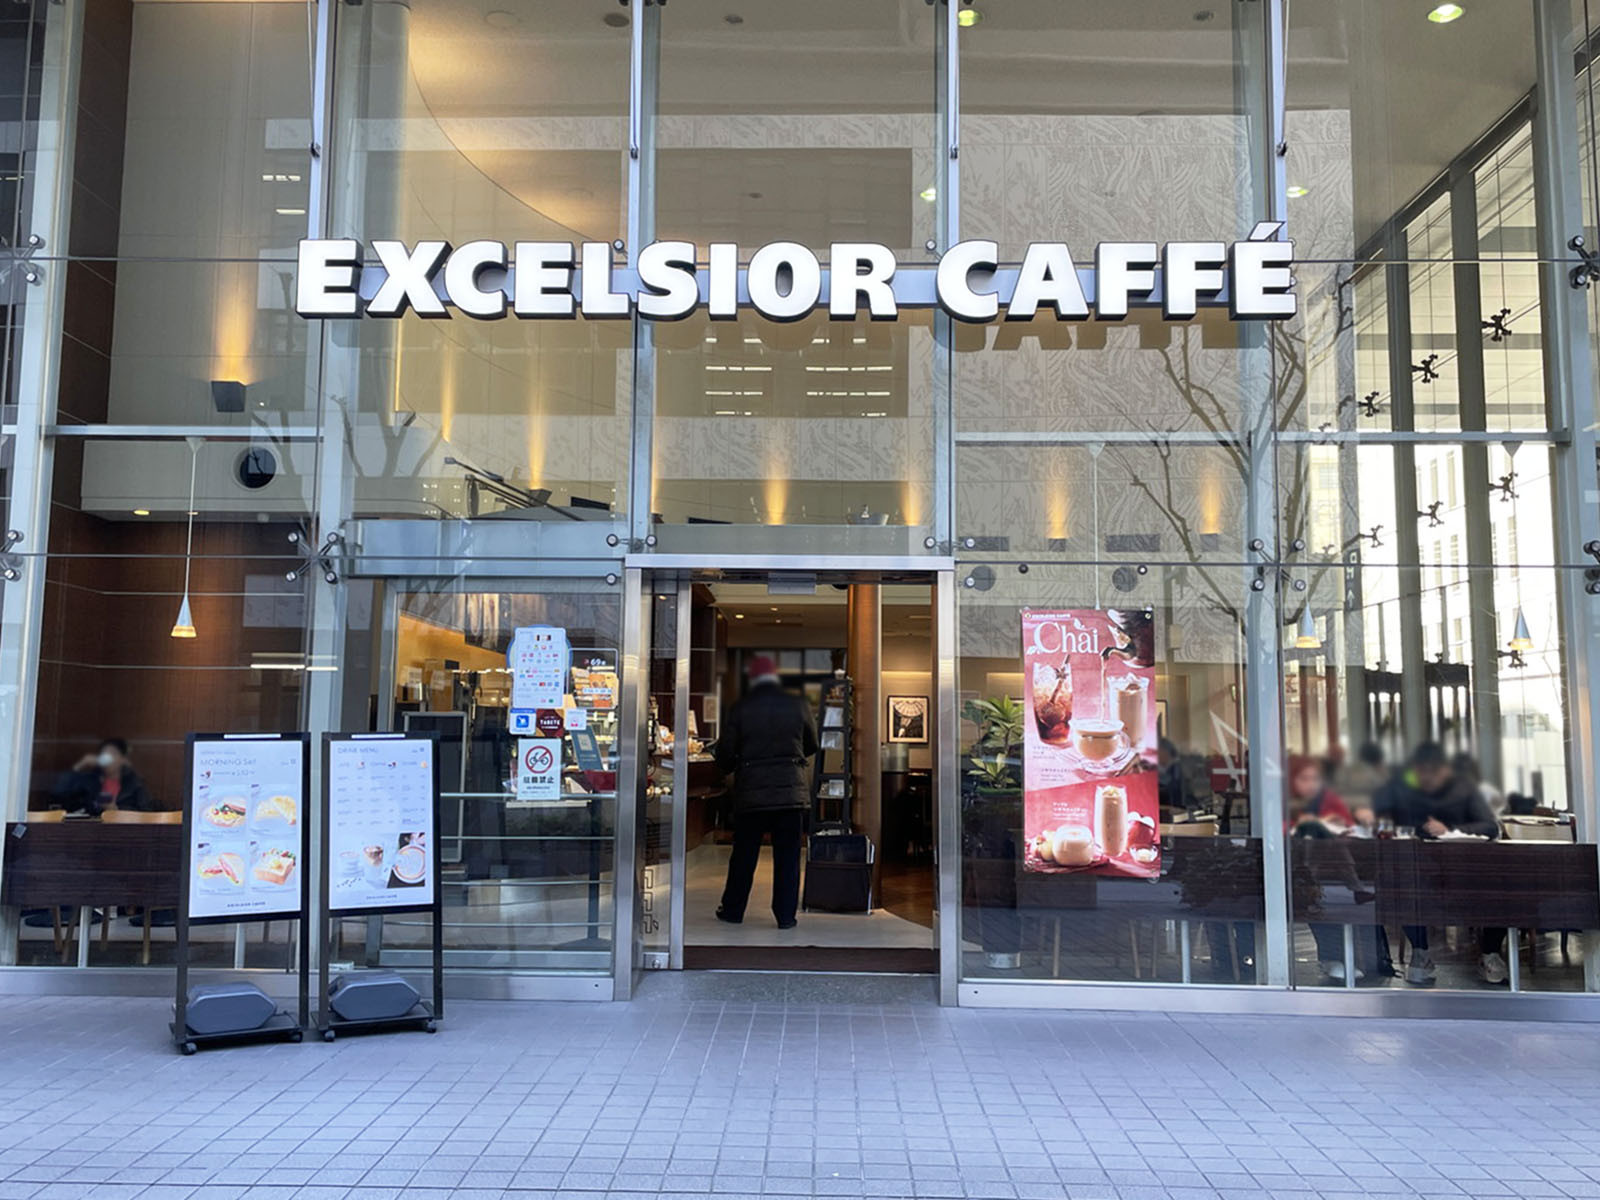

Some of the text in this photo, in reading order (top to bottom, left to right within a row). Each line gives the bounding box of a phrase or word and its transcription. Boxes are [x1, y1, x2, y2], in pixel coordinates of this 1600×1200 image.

[297, 221, 1297, 321] EXCELSIOR CAFFÉ
[1033, 621, 1099, 654] Chai
